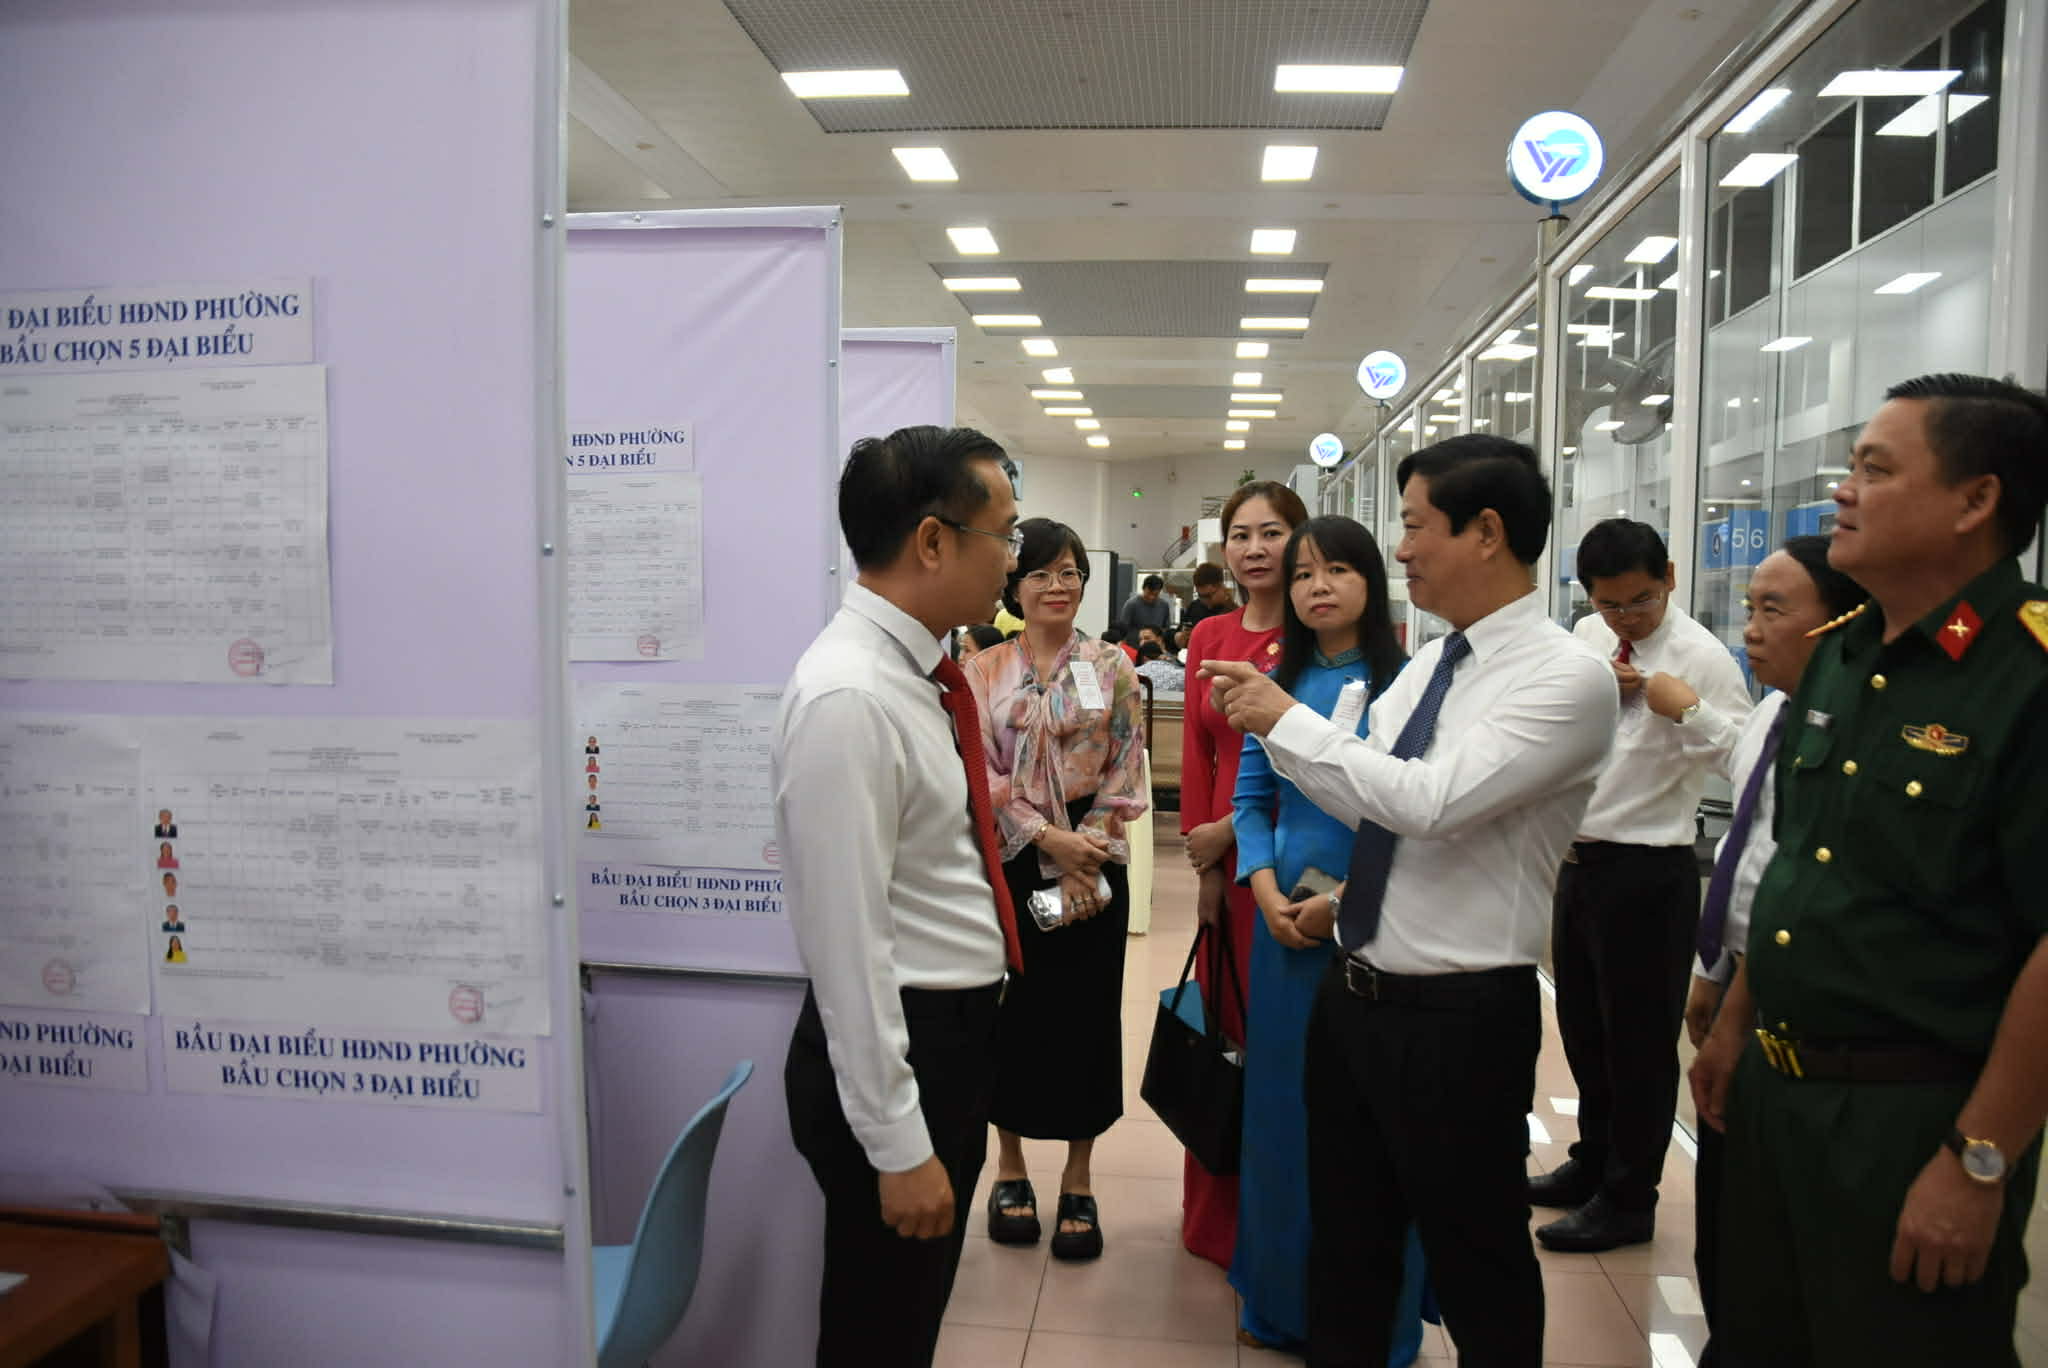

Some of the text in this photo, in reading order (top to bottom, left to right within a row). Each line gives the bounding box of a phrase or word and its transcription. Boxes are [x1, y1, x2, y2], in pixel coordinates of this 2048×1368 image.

[8, 308, 49, 333] ĐẠI
[56, 294, 112, 328] BIỂU
[119, 300, 188, 325] HĐND
[194, 290, 300, 320] PHƯỜNG
[54, 338, 123, 365] CHỌN
[129, 338, 141, 359] 5
[147, 335, 190, 363] ĐẠI
[195, 324, 254, 357] BIỂU
[572, 428, 685, 447] HĐND PHƯỜNG
[577, 455, 585, 467] 5
[589, 454, 616, 470] ĐẠI
[621, 448, 656, 466] BIỂU
[625, 875, 652, 889] ĐẠI
[656, 870, 691, 889] BIỂU
[697, 877, 740, 891] HĐND
[654, 896, 698, 911] CHỌN
[702, 898, 710, 909] 3
[713, 899, 740, 913] ĐẠI
[37, 1020, 134, 1049] PHƯỜNG
[175, 1022, 525, 1069] BẦU ĐẠI BIỂU HĐND PHƯỜNG
[39, 1049, 92, 1078] BIỂU
[222, 1058, 480, 1101] BẦU CHỌN 3 ĐẠI BIỂU
